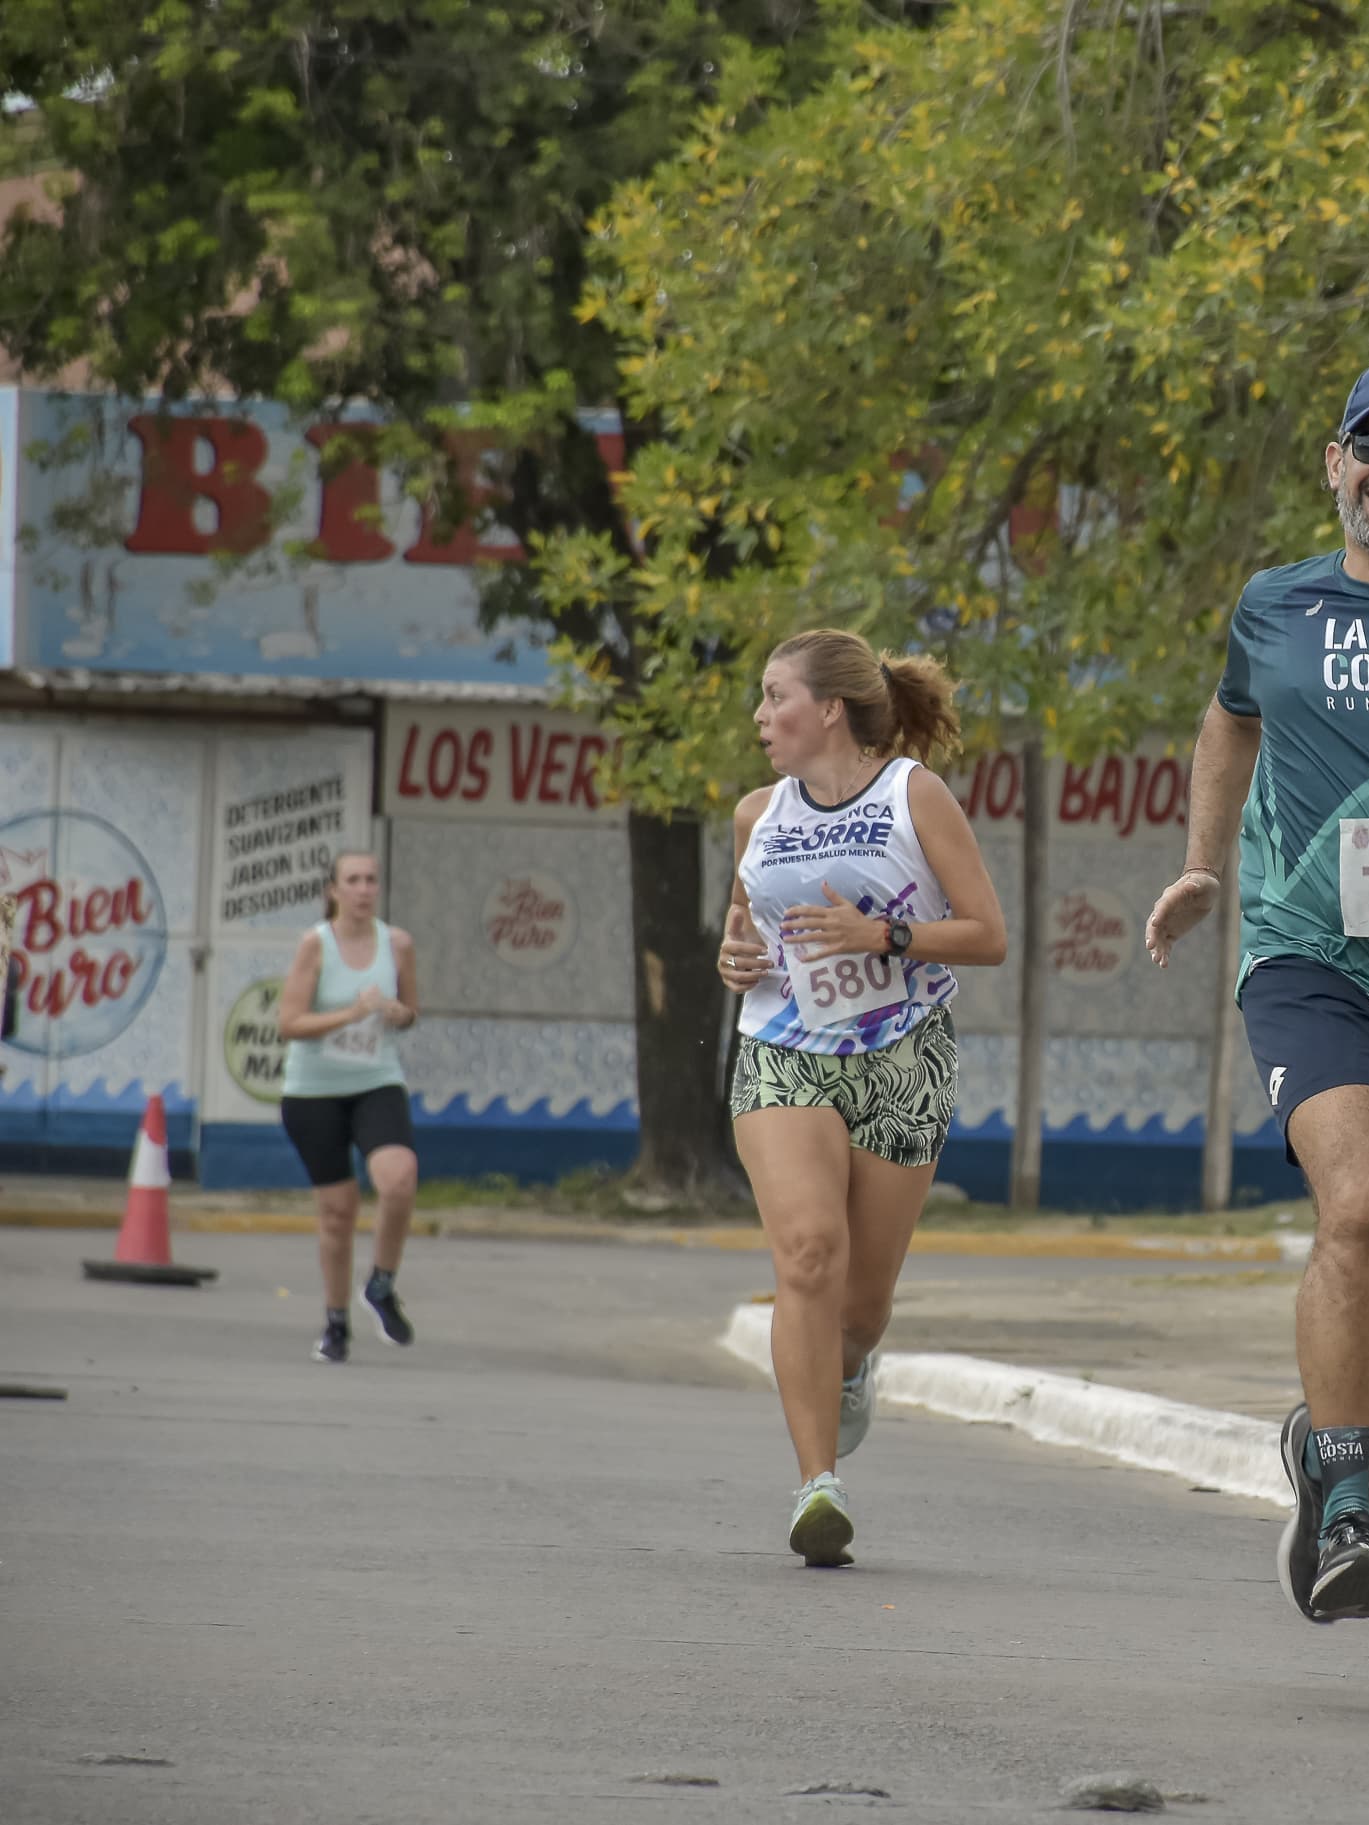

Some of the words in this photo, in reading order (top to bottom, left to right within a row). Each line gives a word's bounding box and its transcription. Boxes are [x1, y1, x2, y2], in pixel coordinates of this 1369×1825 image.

[124, 414, 628, 566] BIE
[1324, 618, 1368, 650] LA
[398, 721, 493, 801] LOS
[509, 721, 624, 811] VER
[225, 774, 344, 829] DETERGENTE
[227, 809, 344, 858] SUAVIZANTE
[761, 858, 778, 868] POR
[779, 853, 817, 865] NUESTRA
[818, 849, 847, 859] SALUD
[848, 849, 887, 858] MENTAL
[16, 876, 153, 954] Bien
[809, 952, 892, 1009] 580
[1316, 1432, 1332, 1447] LA
[1320, 1442, 1363, 1460] COSTA
